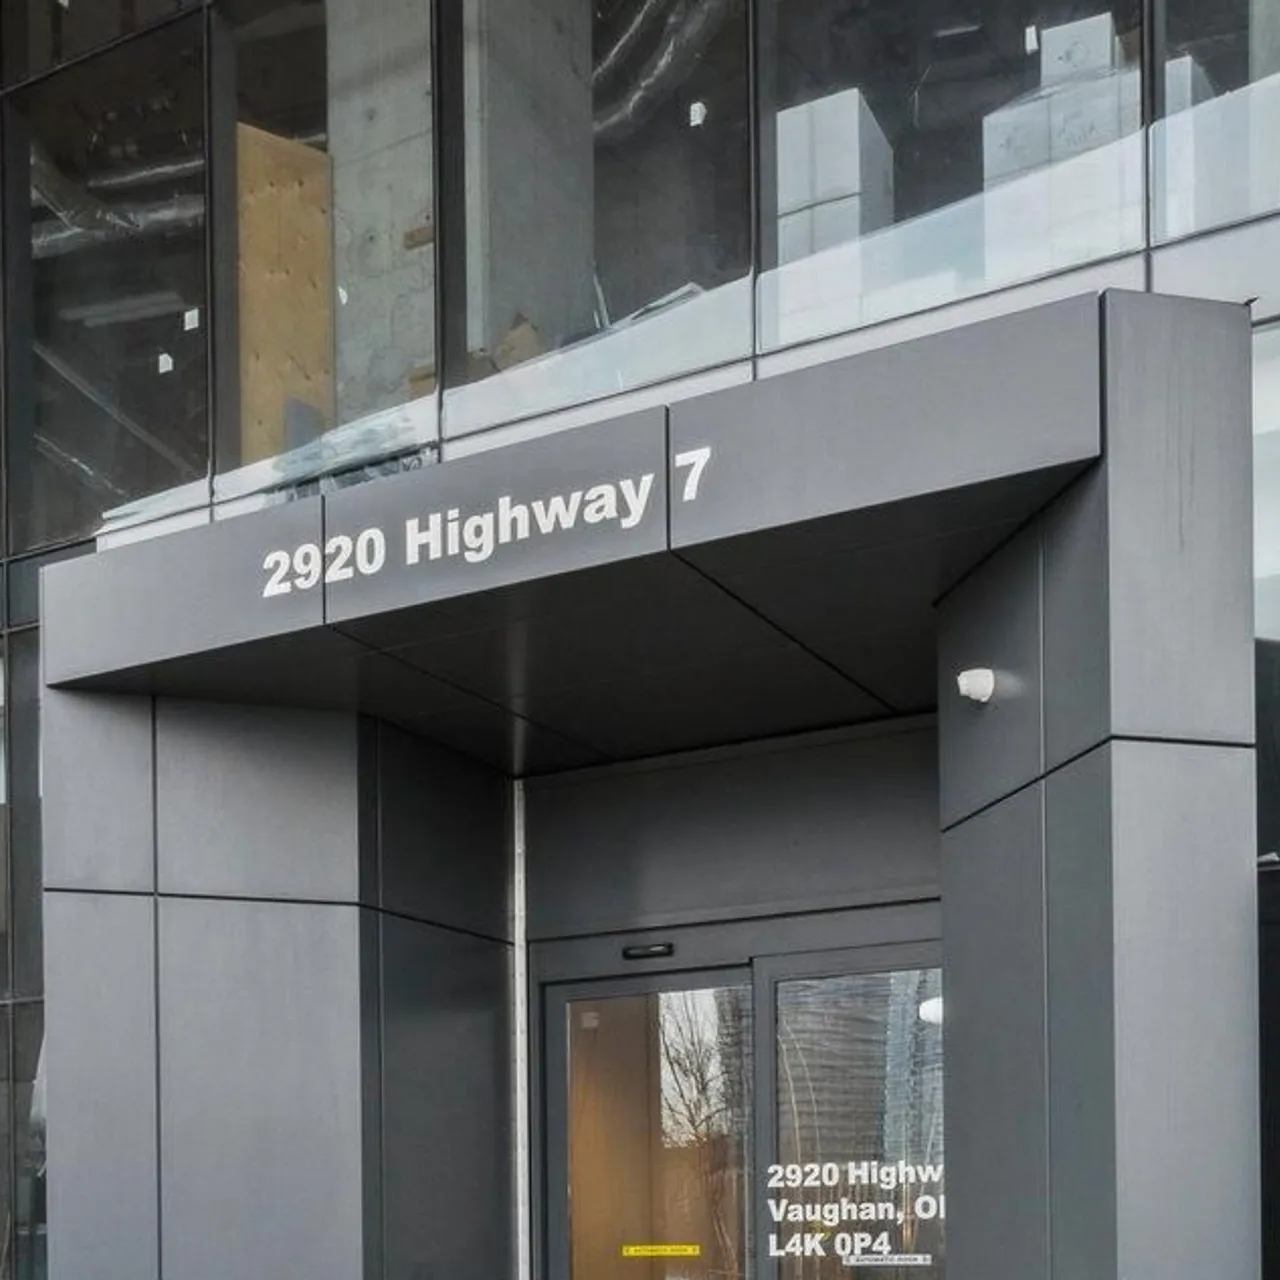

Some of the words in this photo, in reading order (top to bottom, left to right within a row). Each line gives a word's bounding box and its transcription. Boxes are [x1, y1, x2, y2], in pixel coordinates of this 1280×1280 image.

[262, 527, 387, 598] 2920
[404, 472, 655, 565] Highway
[674, 446, 712, 502] 7
[767, 1162, 840, 1188] 2920
[767, 1197, 906, 1227] Vaughan,
[769, 1233, 827, 1257] L4K
